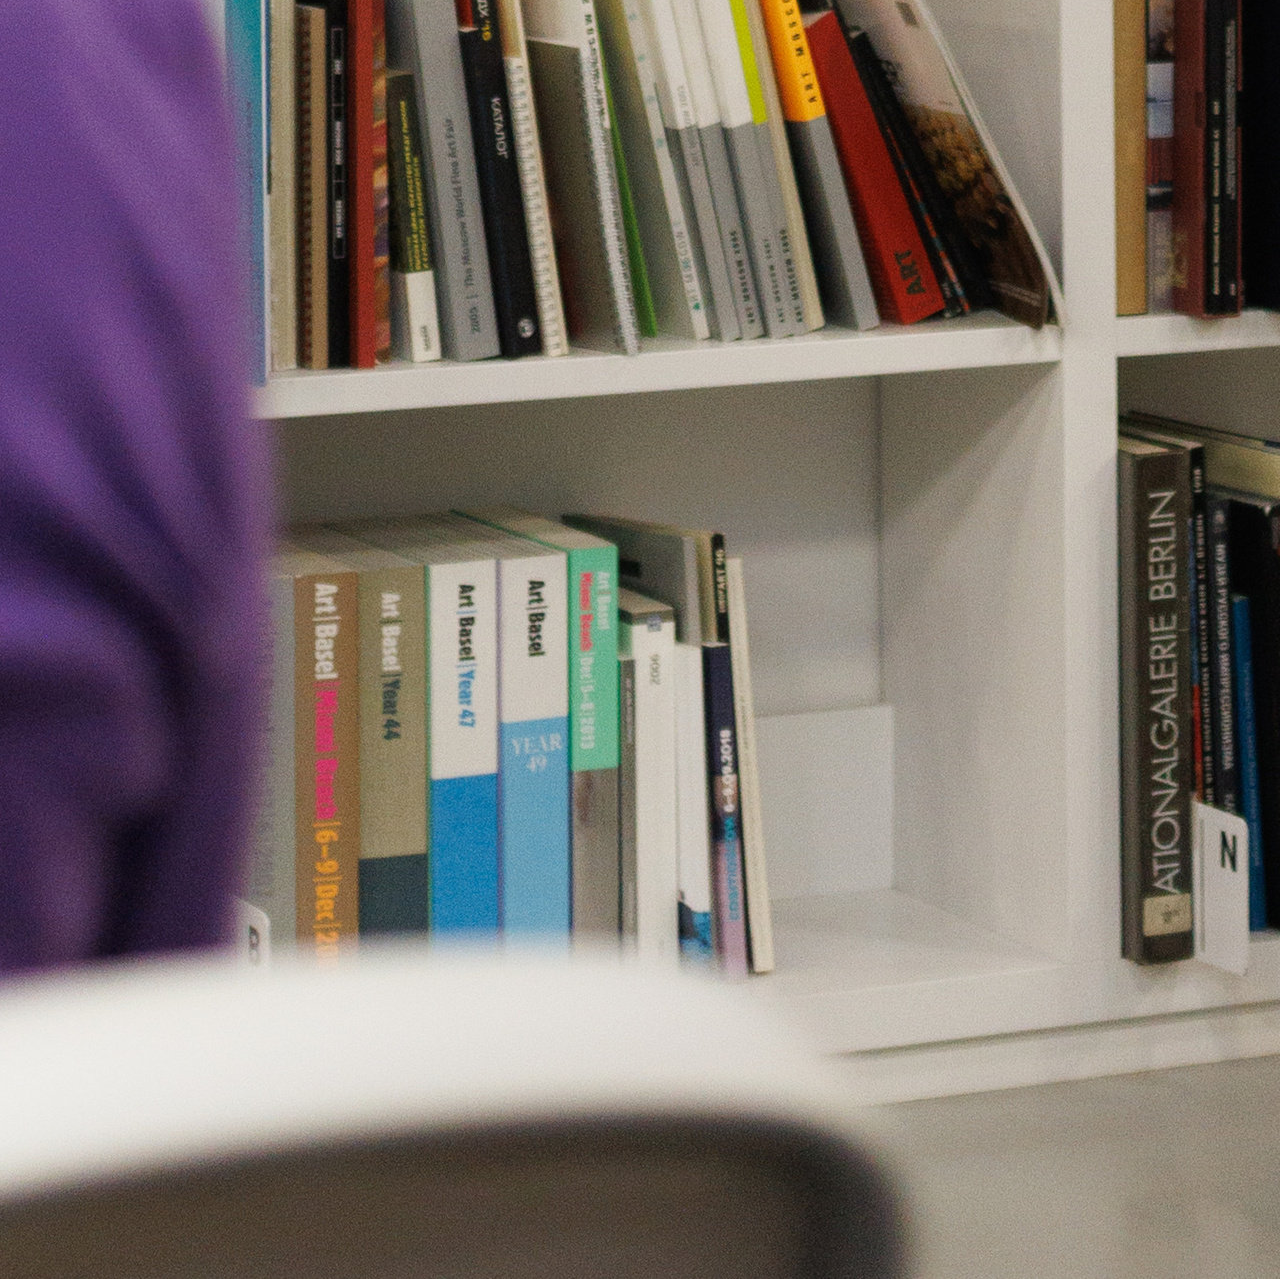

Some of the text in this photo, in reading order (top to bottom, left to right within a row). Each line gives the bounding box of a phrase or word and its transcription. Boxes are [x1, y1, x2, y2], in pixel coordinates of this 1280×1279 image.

[799, 71, 818, 104] ART
[443, 119, 455, 140] Fair
[446, 142, 458, 160] Art
[490, 97, 509, 159] КАТАЛОГ
[449, 161, 462, 185] Fine
[453, 189, 465, 219] World
[457, 222, 473, 266] Moscow
[462, 270, 475, 290] The
[893, 249, 925, 296] ART
[313, 583, 338, 614] Art
[527, 580, 546, 658] Art Basel
[313, 623, 338, 681] Basel
[381, 591, 401, 741] Art Basel Year 44
[458, 583, 476, 728] Art Basel Year 47
[1214, 543, 1235, 772] МУЗЕЙ РУССКОГО ИМПРЕССИОНИЗМА
[1147, 490, 1181, 895] ATIONALGALERIE BERLIN
[313, 690, 338, 753] Miami
[313, 758, 338, 820] Beach
[1219, 830, 1238, 873] N
